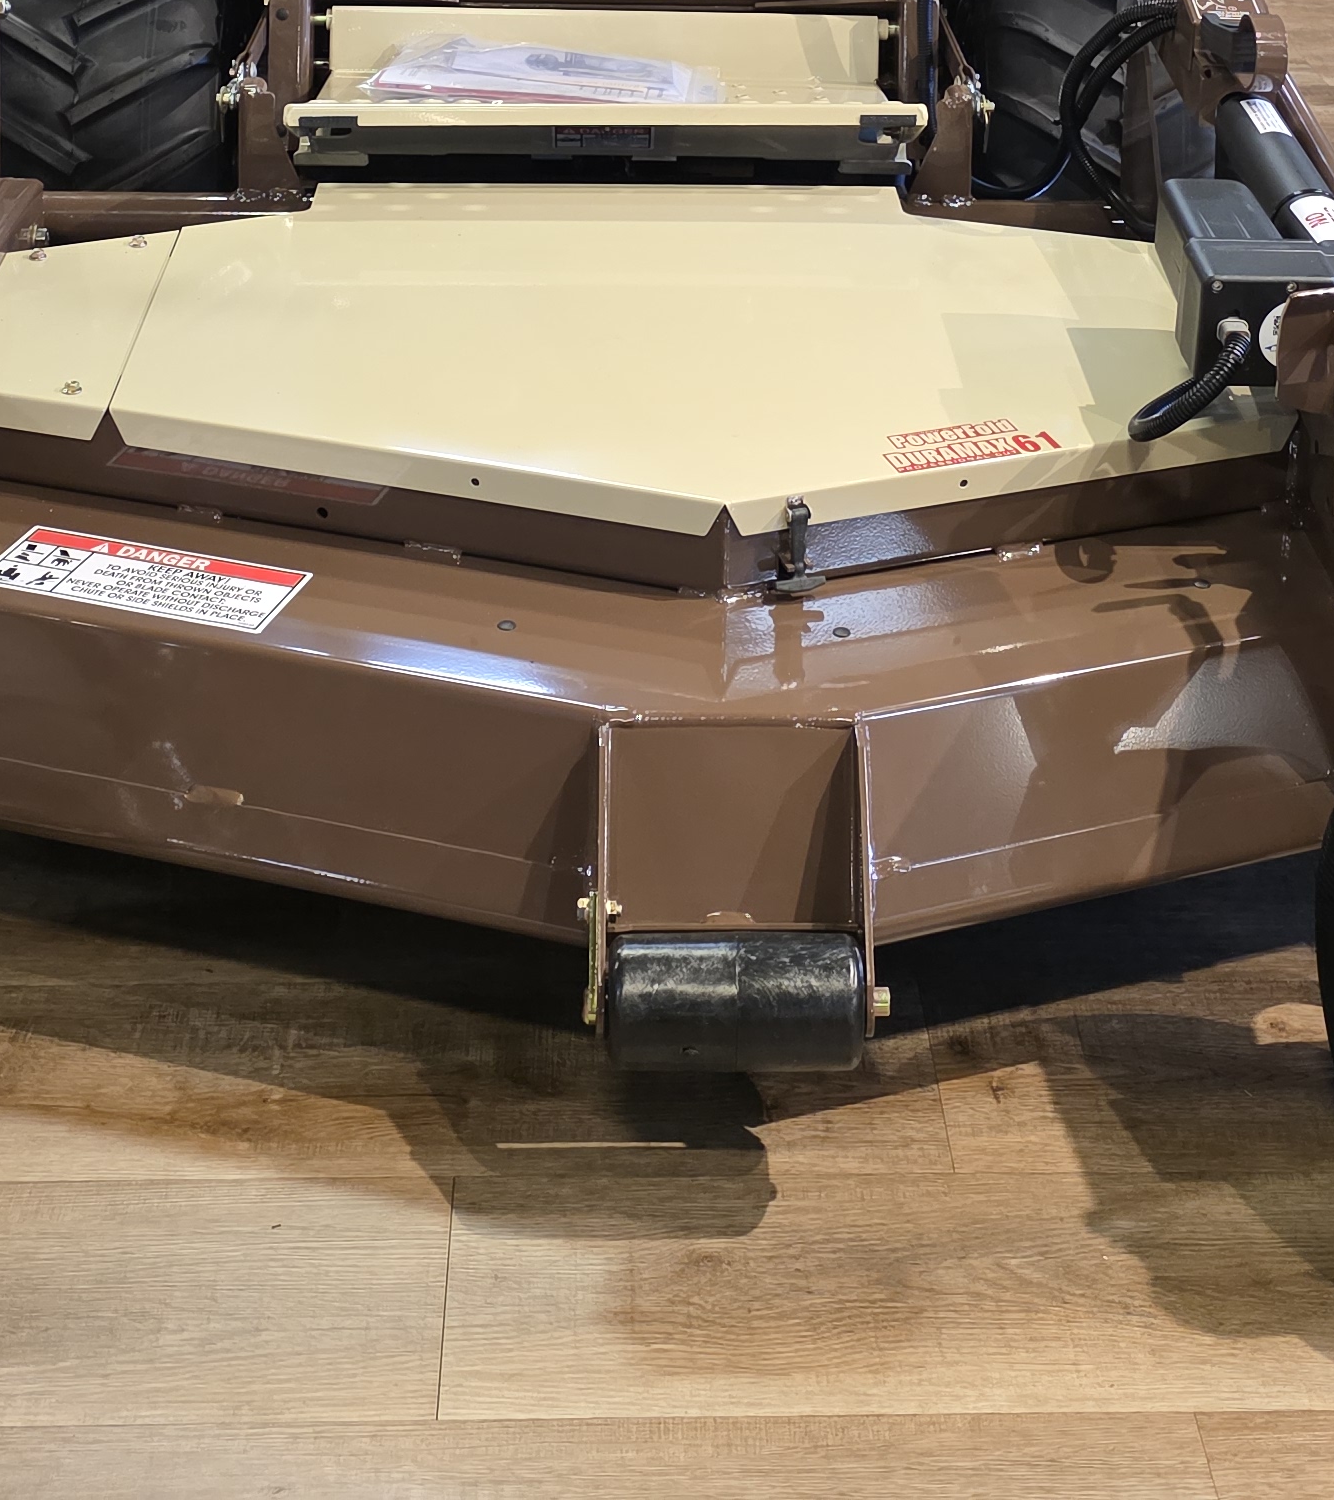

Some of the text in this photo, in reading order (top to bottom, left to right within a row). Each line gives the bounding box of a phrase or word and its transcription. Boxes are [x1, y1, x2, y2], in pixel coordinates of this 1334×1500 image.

[1012, 431, 1062, 453] 61
[898, 455, 991, 472] PROFESSIONAL
[116, 546, 211, 570] DANGER
[93, 569, 262, 603] DEATH FROM THROWN OBJECTS
[122, 567, 158, 578] AVOID
[159, 573, 204, 586] SERIOUS
[205, 582, 244, 592] INJURY
[147, 564, 231, 584] KEEP AWAY!
[66, 578, 266, 618] NEVER OPERATE WITHOUT DISCHARGE
[70, 585, 106, 597] CHUTE
[107, 592, 125, 600] OR
[125, 596, 151, 605] SIDE
[151, 600, 196, 613] SHIELDS
[209, 611, 246, 622] PLACE.
[134, 585, 170, 593] BLADE
[171, 590, 226, 604] CONTACT.
